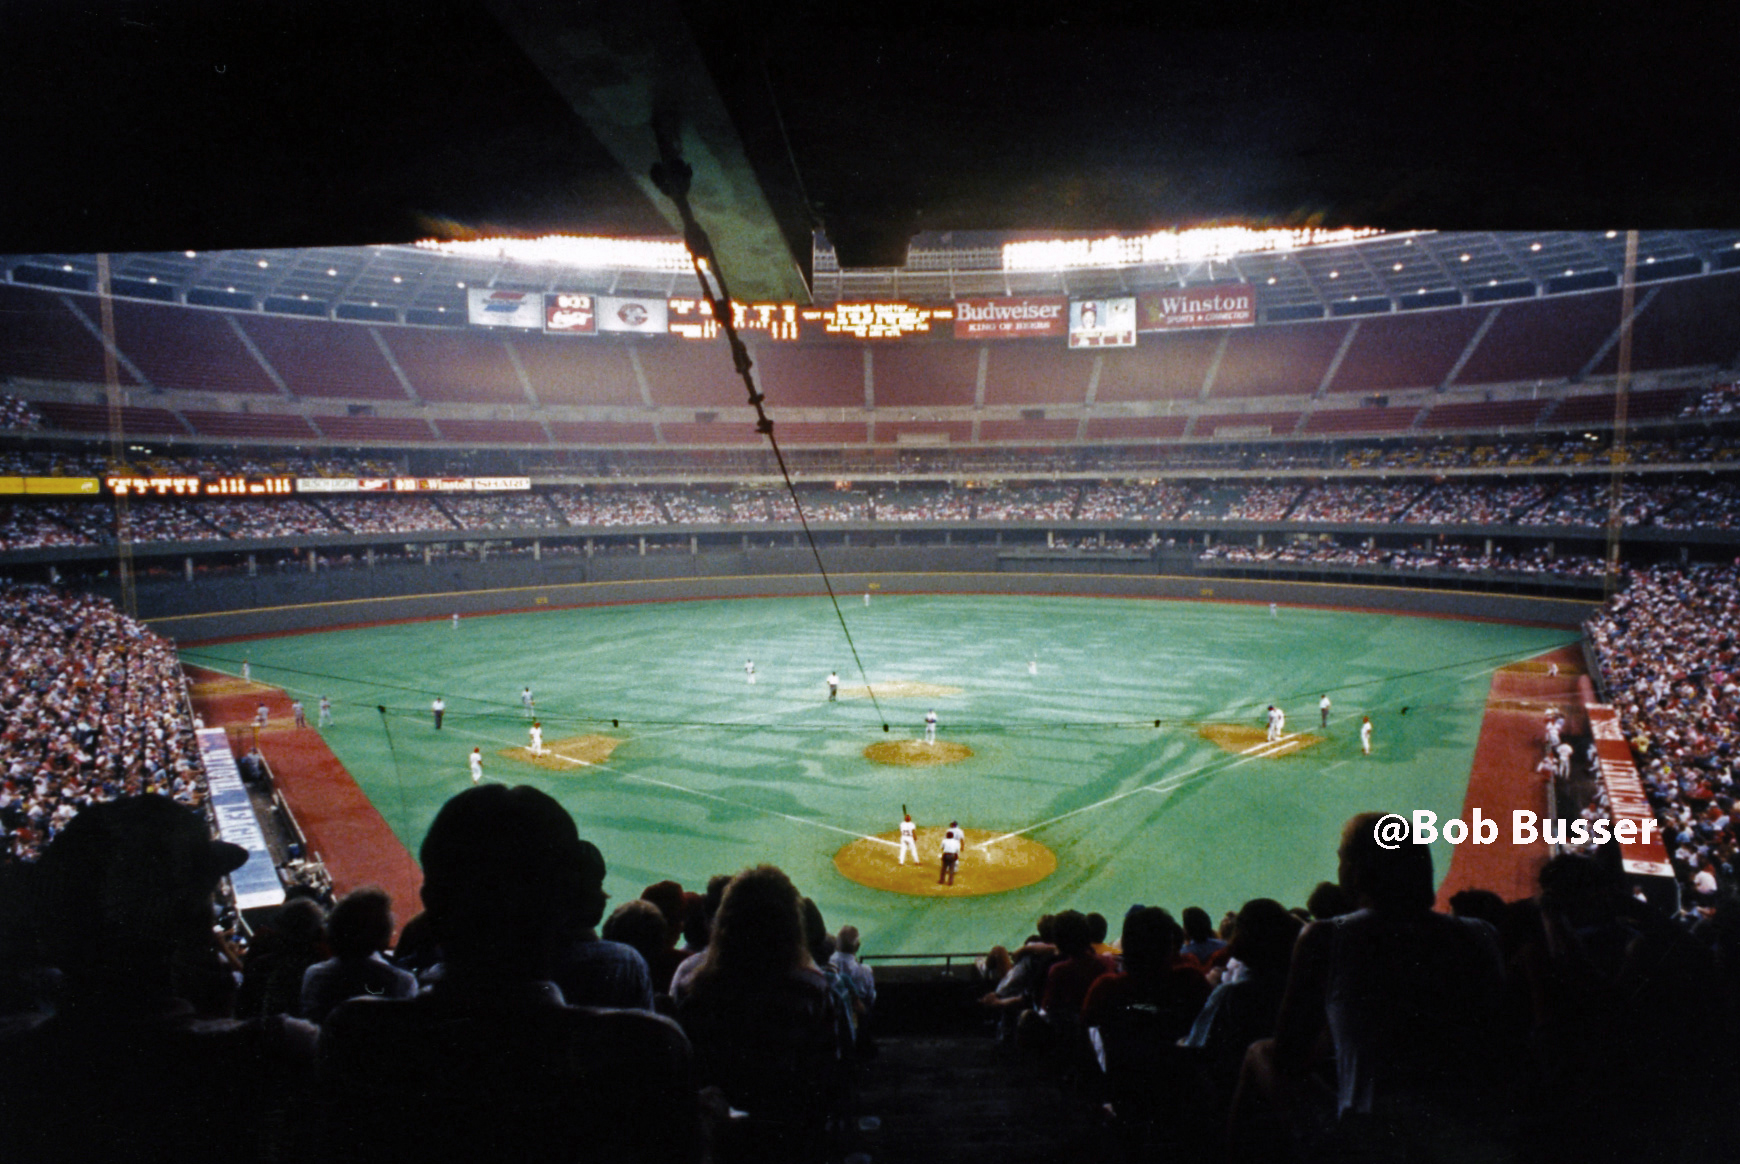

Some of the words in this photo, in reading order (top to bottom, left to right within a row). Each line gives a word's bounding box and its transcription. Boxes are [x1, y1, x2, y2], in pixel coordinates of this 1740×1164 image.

[1162, 294, 1249, 314] Winston
[956, 301, 1062, 321] Budweiser
[968, 323, 996, 332] KING
[999, 322, 1013, 331] OF
[1015, 321, 1051, 330] BEERS
[428, 479, 473, 490] Winston
[476, 479, 529, 488] SHARP
